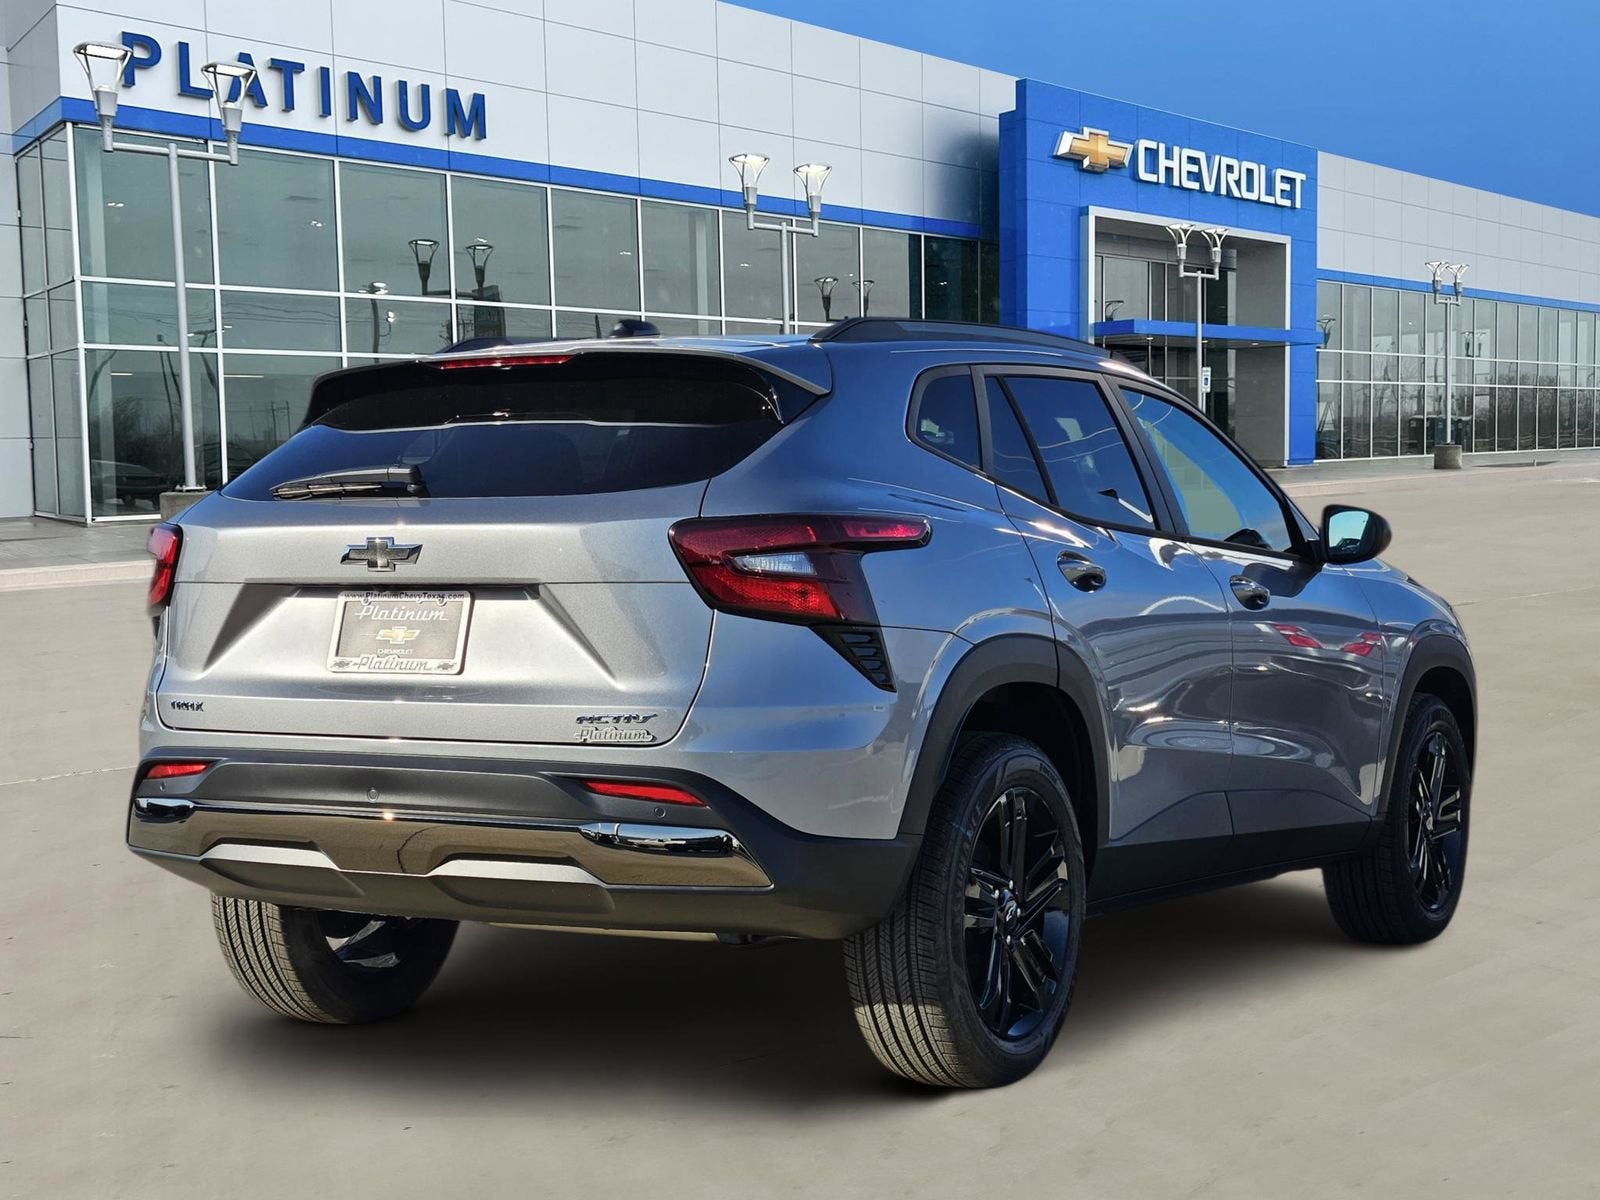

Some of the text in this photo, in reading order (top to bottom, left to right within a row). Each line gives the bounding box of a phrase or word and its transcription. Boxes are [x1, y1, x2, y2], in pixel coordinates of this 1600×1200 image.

[120, 31, 487, 141] PLATINUM
[1136, 138, 1306, 209] CHEVROLET
[354, 605, 449, 621] Platinum
[353, 655, 432, 671] Platinum
[575, 713, 658, 724] ACTIV
[575, 727, 653, 741] Platinum
